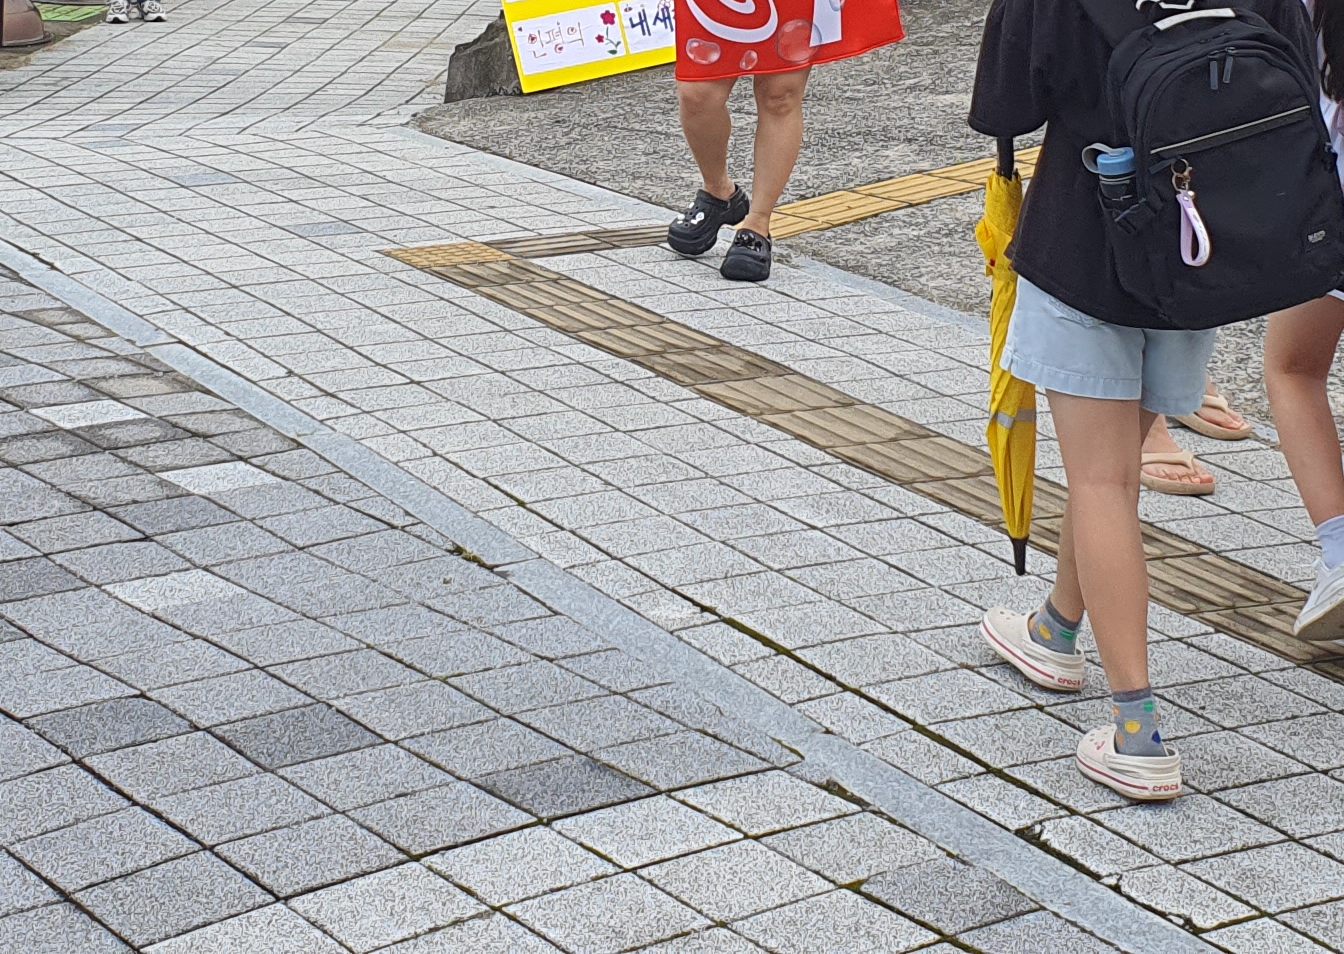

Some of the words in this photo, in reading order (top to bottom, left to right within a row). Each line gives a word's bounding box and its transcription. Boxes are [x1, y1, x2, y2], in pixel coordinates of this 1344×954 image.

[528, 22, 585, 59] 인평의
[629, 8, 652, 36] 내
[652, 5, 675, 33] 새
